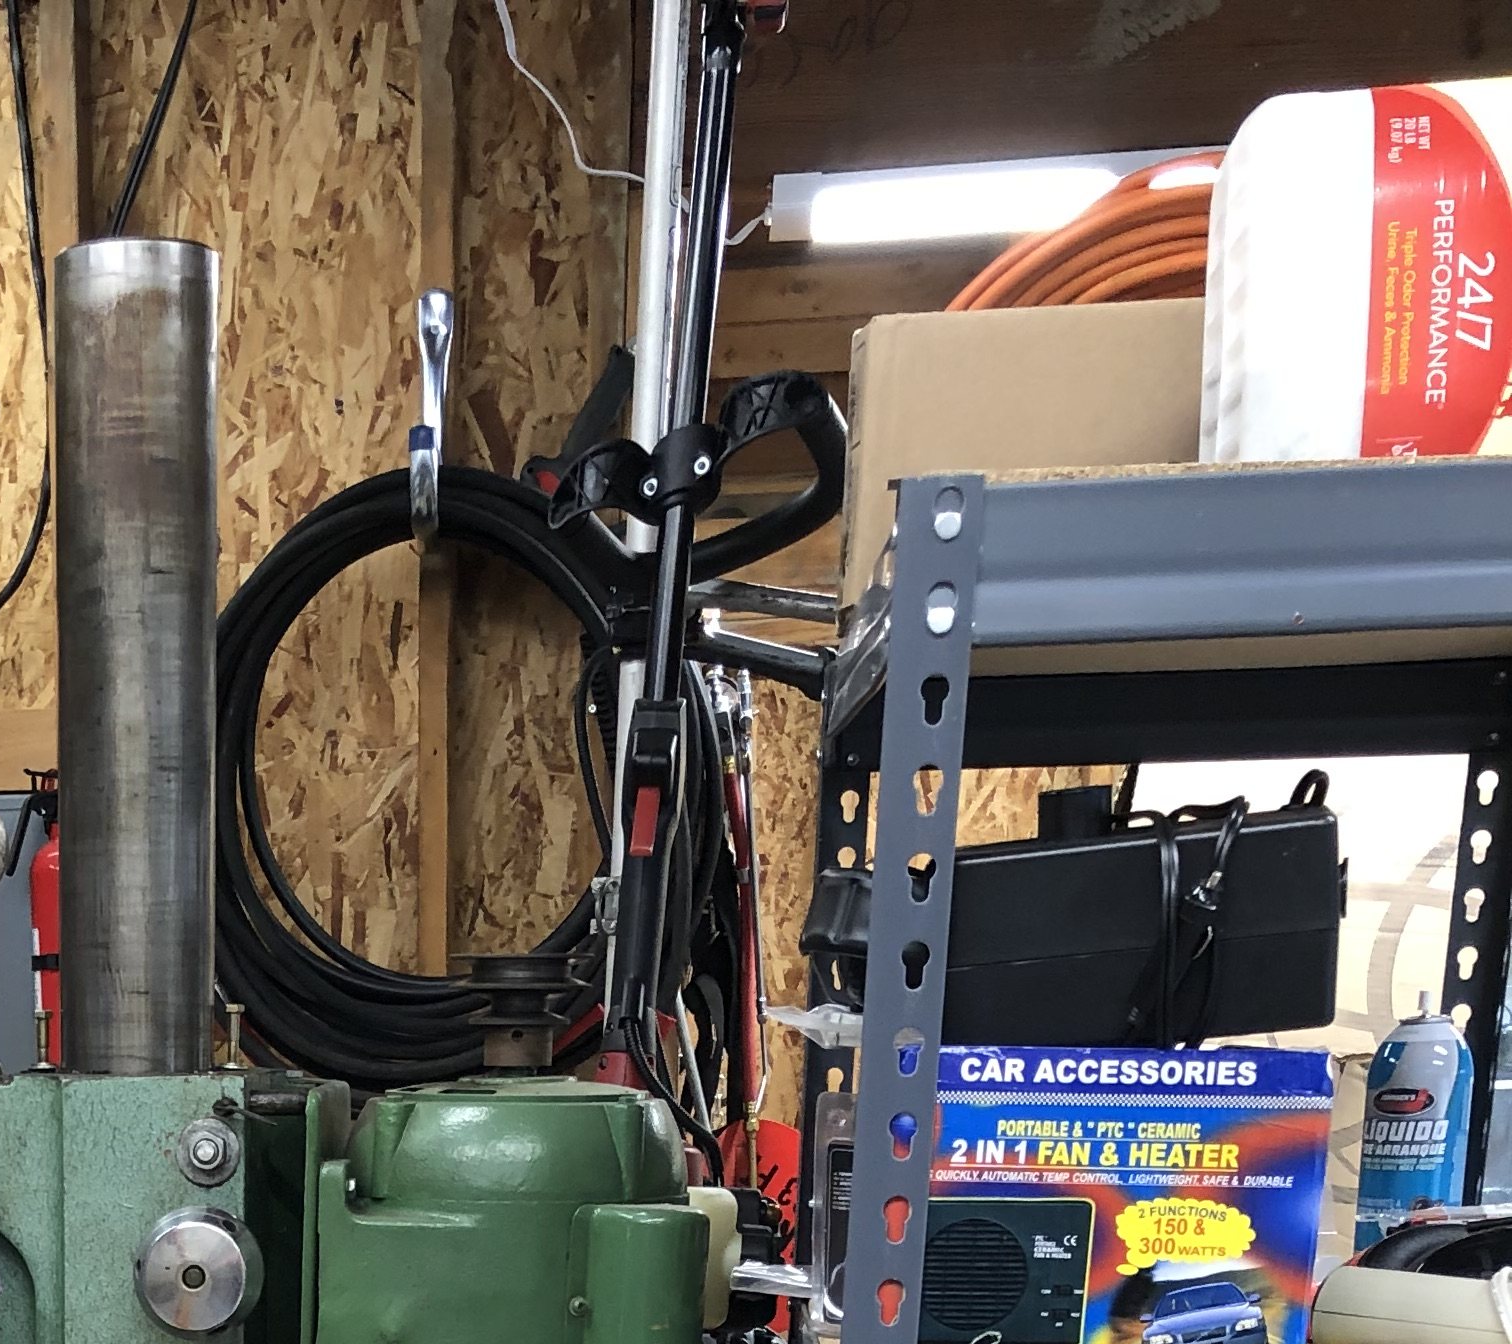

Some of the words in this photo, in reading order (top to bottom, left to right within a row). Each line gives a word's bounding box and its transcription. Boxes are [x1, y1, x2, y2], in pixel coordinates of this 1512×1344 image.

[1404, 117, 1416, 130] 20
[1418, 116, 1431, 133] NET
[1402, 227, 1419, 266] Triple
[1401, 269, 1417, 307] Odor
[1424, 199, 1455, 405] PERFORMANCE
[1454, 251, 1496, 351] 24/7
[1379, 325, 1397, 395] Ammonia
[1398, 309, 1415, 386] Protection
[960, 1057, 1026, 1084] CAR
[1033, 1059, 1258, 1087] ACCESSORIES
[997, 1120, 1069, 1137] PORTABLE
[1071, 1121, 1083, 1137] &
[1137, 1123, 1201, 1140] CERAMIC
[951, 1139, 968, 1164] 2
[976, 1140, 1009, 1165] IN
[1014, 1141, 1028, 1165] 1
[1037, 1141, 1089, 1167] FAN
[1099, 1143, 1119, 1167] &
[1128, 1144, 1240, 1168] HEATER
[981, 1171, 1040, 1183] AUTOMATIC
[1202, 1175, 1230, 1187] SAFE
[1244, 1176, 1294, 1189] DURABLE
[1138, 1208, 1145, 1219] 2
[1149, 1205, 1228, 1222] FUNCTIONS
[1153, 1218, 1188, 1236] 150
[1193, 1219, 1206, 1237] &
[1138, 1237, 1176, 1256] 300
[1178, 1246, 1227, 1257] WATTS
